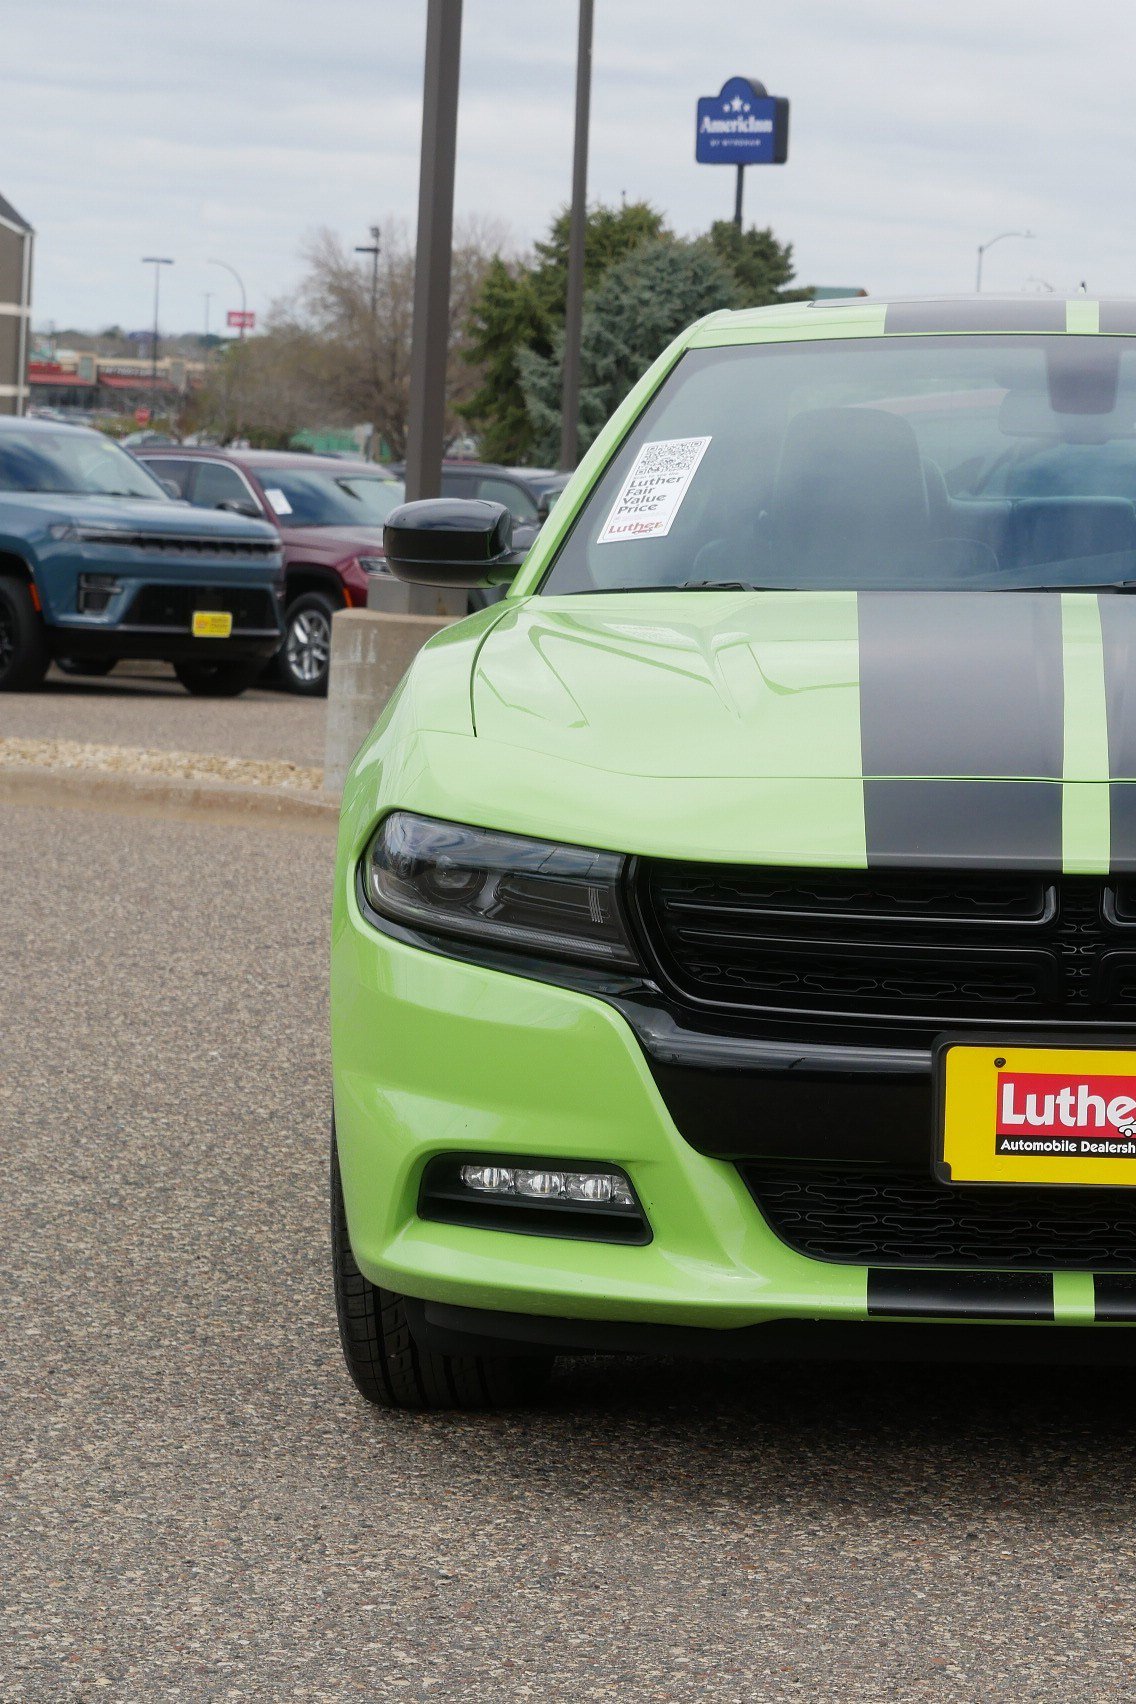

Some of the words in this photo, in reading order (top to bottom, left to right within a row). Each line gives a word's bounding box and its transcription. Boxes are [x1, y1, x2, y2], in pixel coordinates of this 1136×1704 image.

[700, 115, 773, 133] AmericInn
[630, 476, 684, 488] Luther
[625, 486, 655, 497] Fair
[623, 495, 667, 505] Value
[617, 503, 658, 515] Price
[608, 521, 663, 534] Luther
[1000, 1139, 1077, 1153] Automobile
